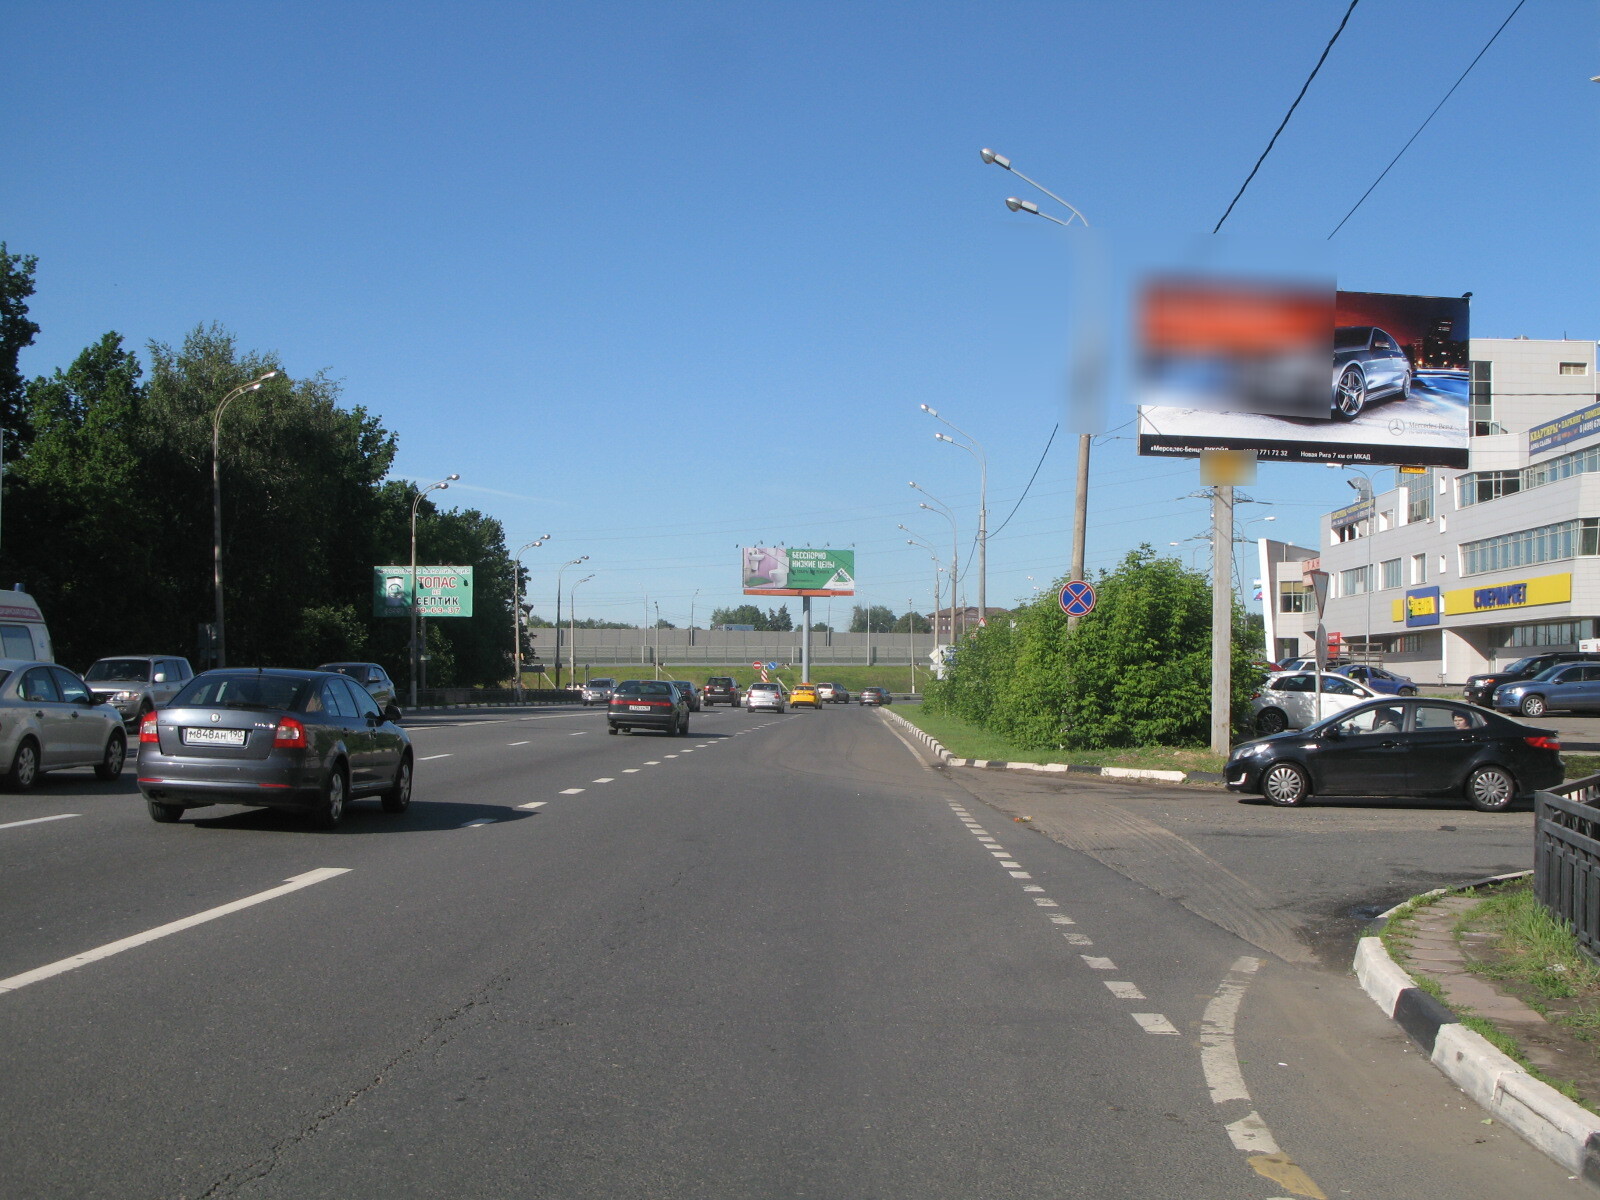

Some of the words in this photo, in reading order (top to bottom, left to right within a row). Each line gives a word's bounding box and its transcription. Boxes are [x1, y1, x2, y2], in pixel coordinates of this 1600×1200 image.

[792, 551, 827, 560] БЕССПОРНО
[792, 560, 816, 568] НИЗКИЕ
[817, 560, 835, 569] ЦЕНЫ
[417, 576, 457, 588] ТОПАС
[416, 597, 459, 605] СЕПТИК
[188, 729, 227, 740] М848АН
